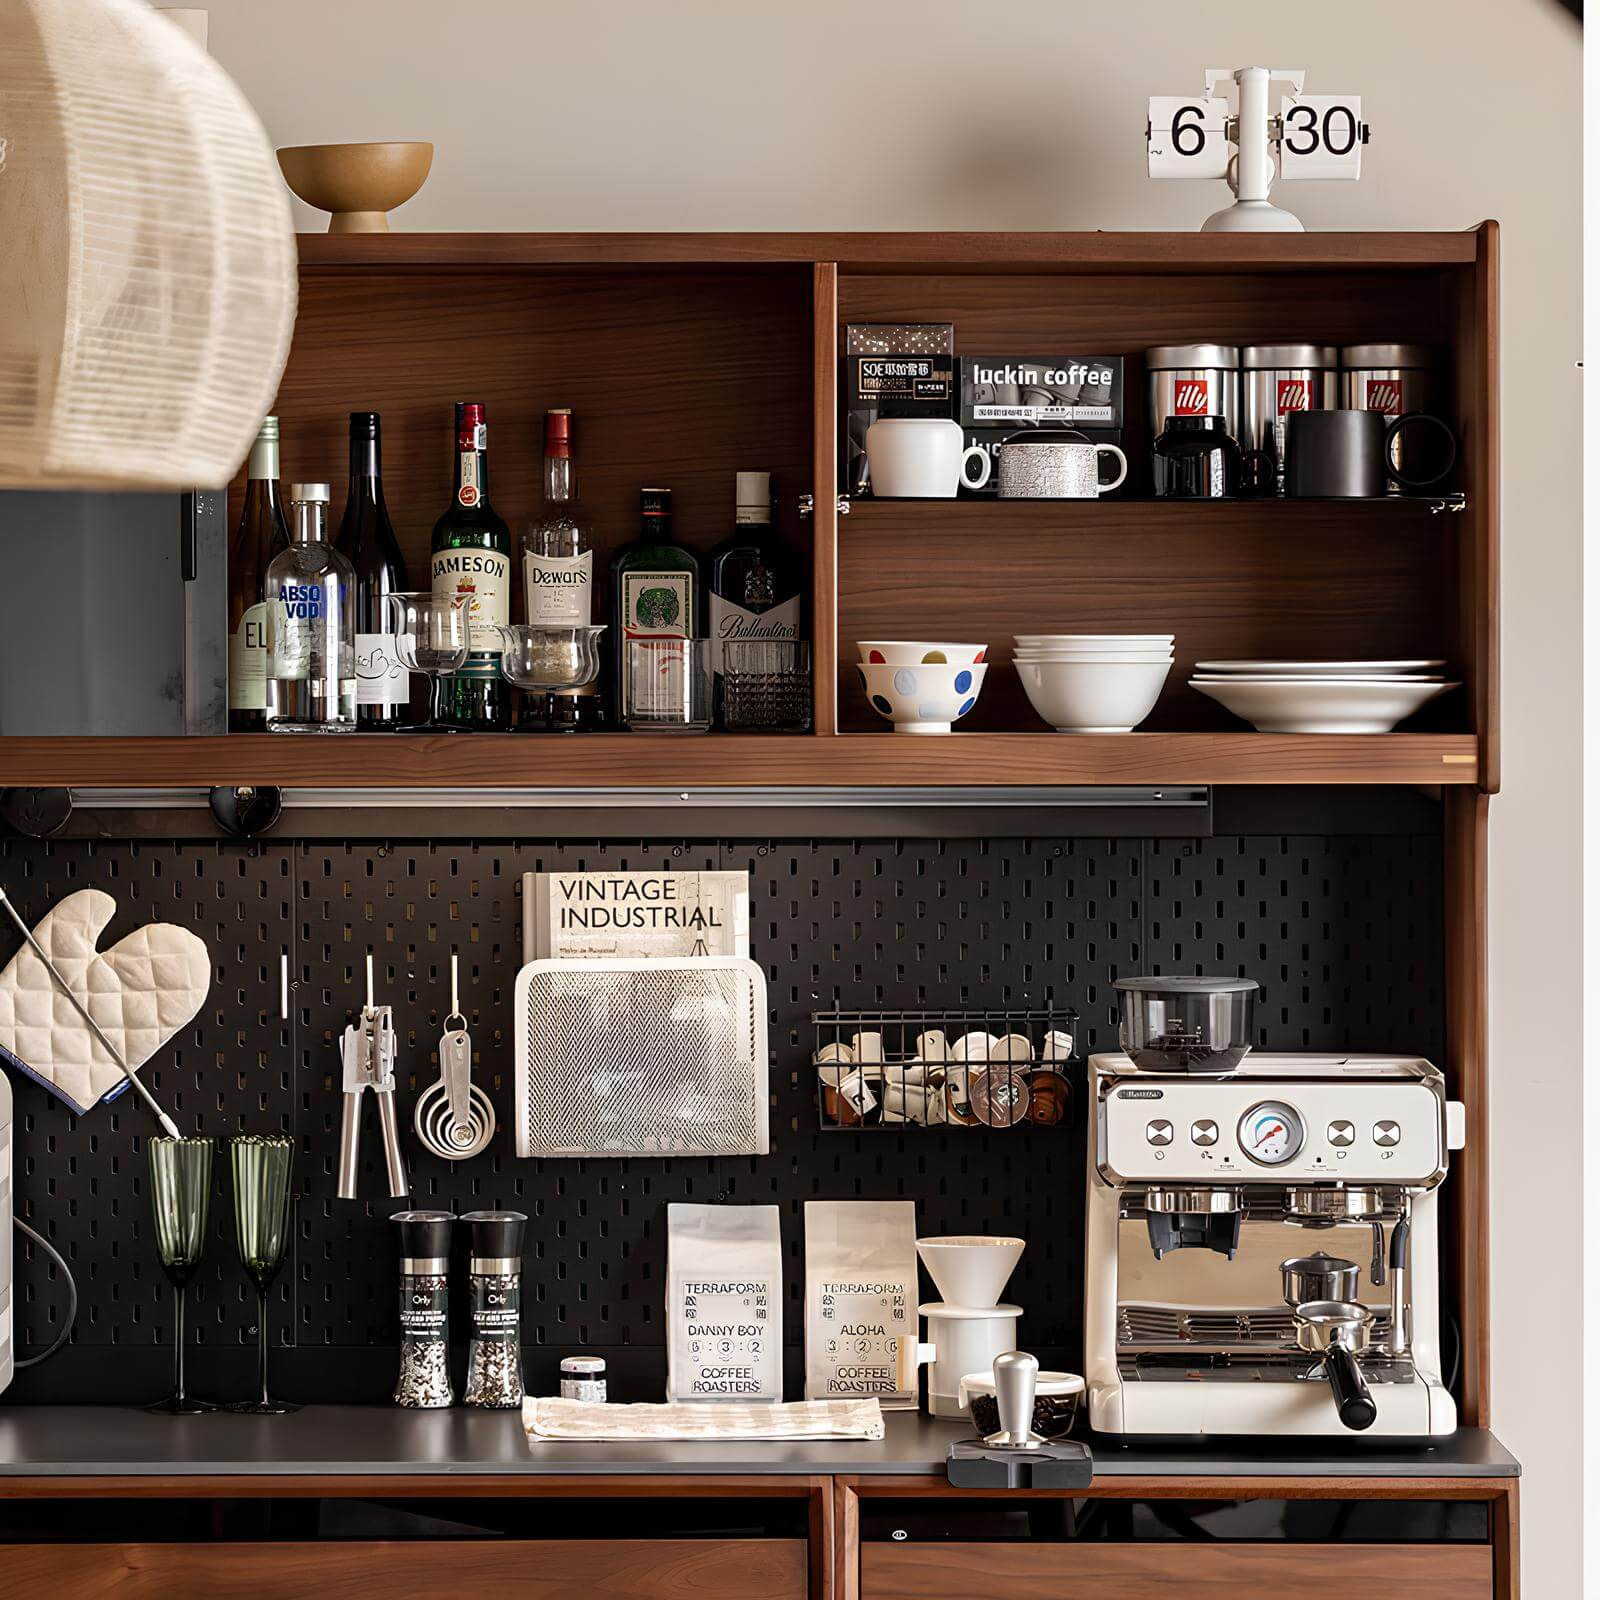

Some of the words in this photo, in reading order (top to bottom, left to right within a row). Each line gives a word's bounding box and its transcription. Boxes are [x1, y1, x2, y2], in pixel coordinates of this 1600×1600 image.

[1171, 105, 1206, 156] 6
[1285, 105, 1356, 156] 30
[973, 364, 1038, 385] luckin
[1043, 364, 1113, 386] coffee
[1176, 385, 1207, 413] illy
[1369, 385, 1401, 413] illy
[432, 556, 505, 580] JAMESON
[559, 879, 677, 900] VINTAGE
[561, 906, 722, 929] INDUSTRIAL
[685, 1283, 767, 1294] TERRAFORM
[822, 1283, 904, 1294] TERRAFORM
[688, 1325, 735, 1336] DANNY
[737, 1325, 764, 1336] BOY
[840, 1325, 886, 1336] ALOHA
[701, 1367, 752, 1378] COFFEE
[838, 1367, 888, 1378] COFFEE
[692, 1380, 761, 1392] ROASTERS
